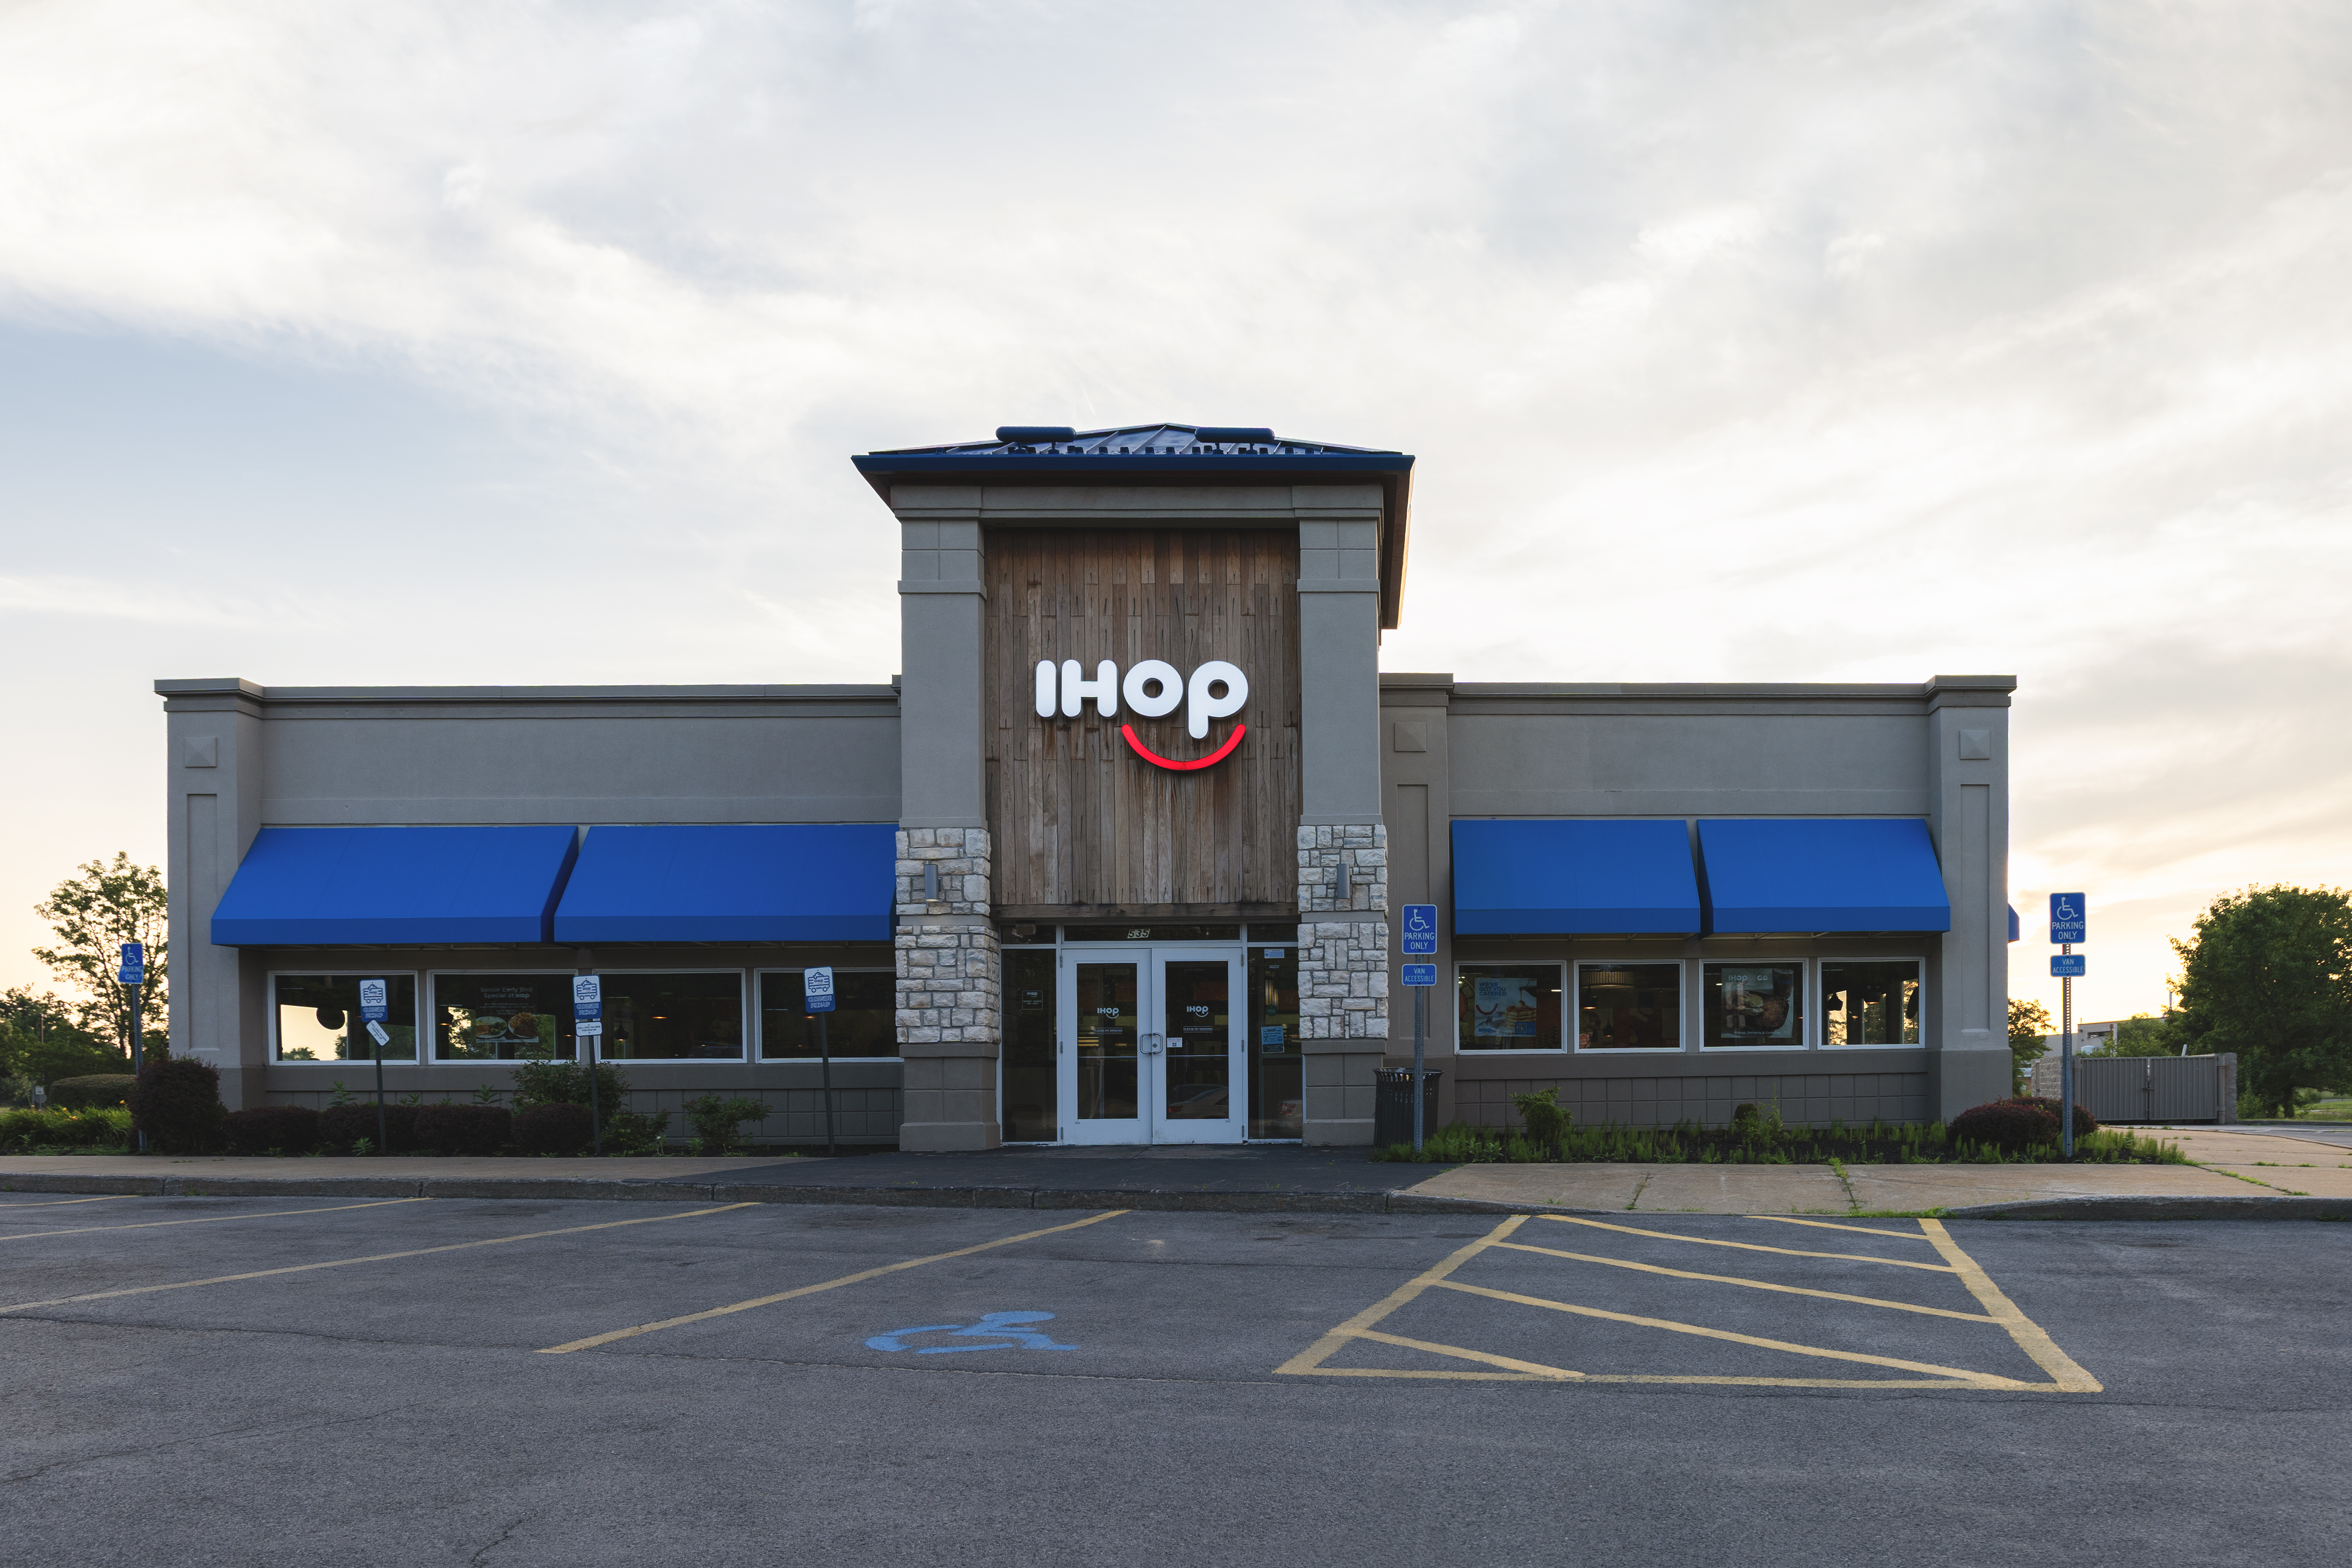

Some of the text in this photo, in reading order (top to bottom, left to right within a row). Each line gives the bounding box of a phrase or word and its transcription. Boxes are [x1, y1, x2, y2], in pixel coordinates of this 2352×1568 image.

[1036, 659, 1248, 739] IHOP
[2052, 921, 2084, 930] PARKING
[1129, 929, 1149, 937] 535
[1097, 1007, 1119, 1016] IHOP
[1187, 1006, 1209, 1014] IHOP
